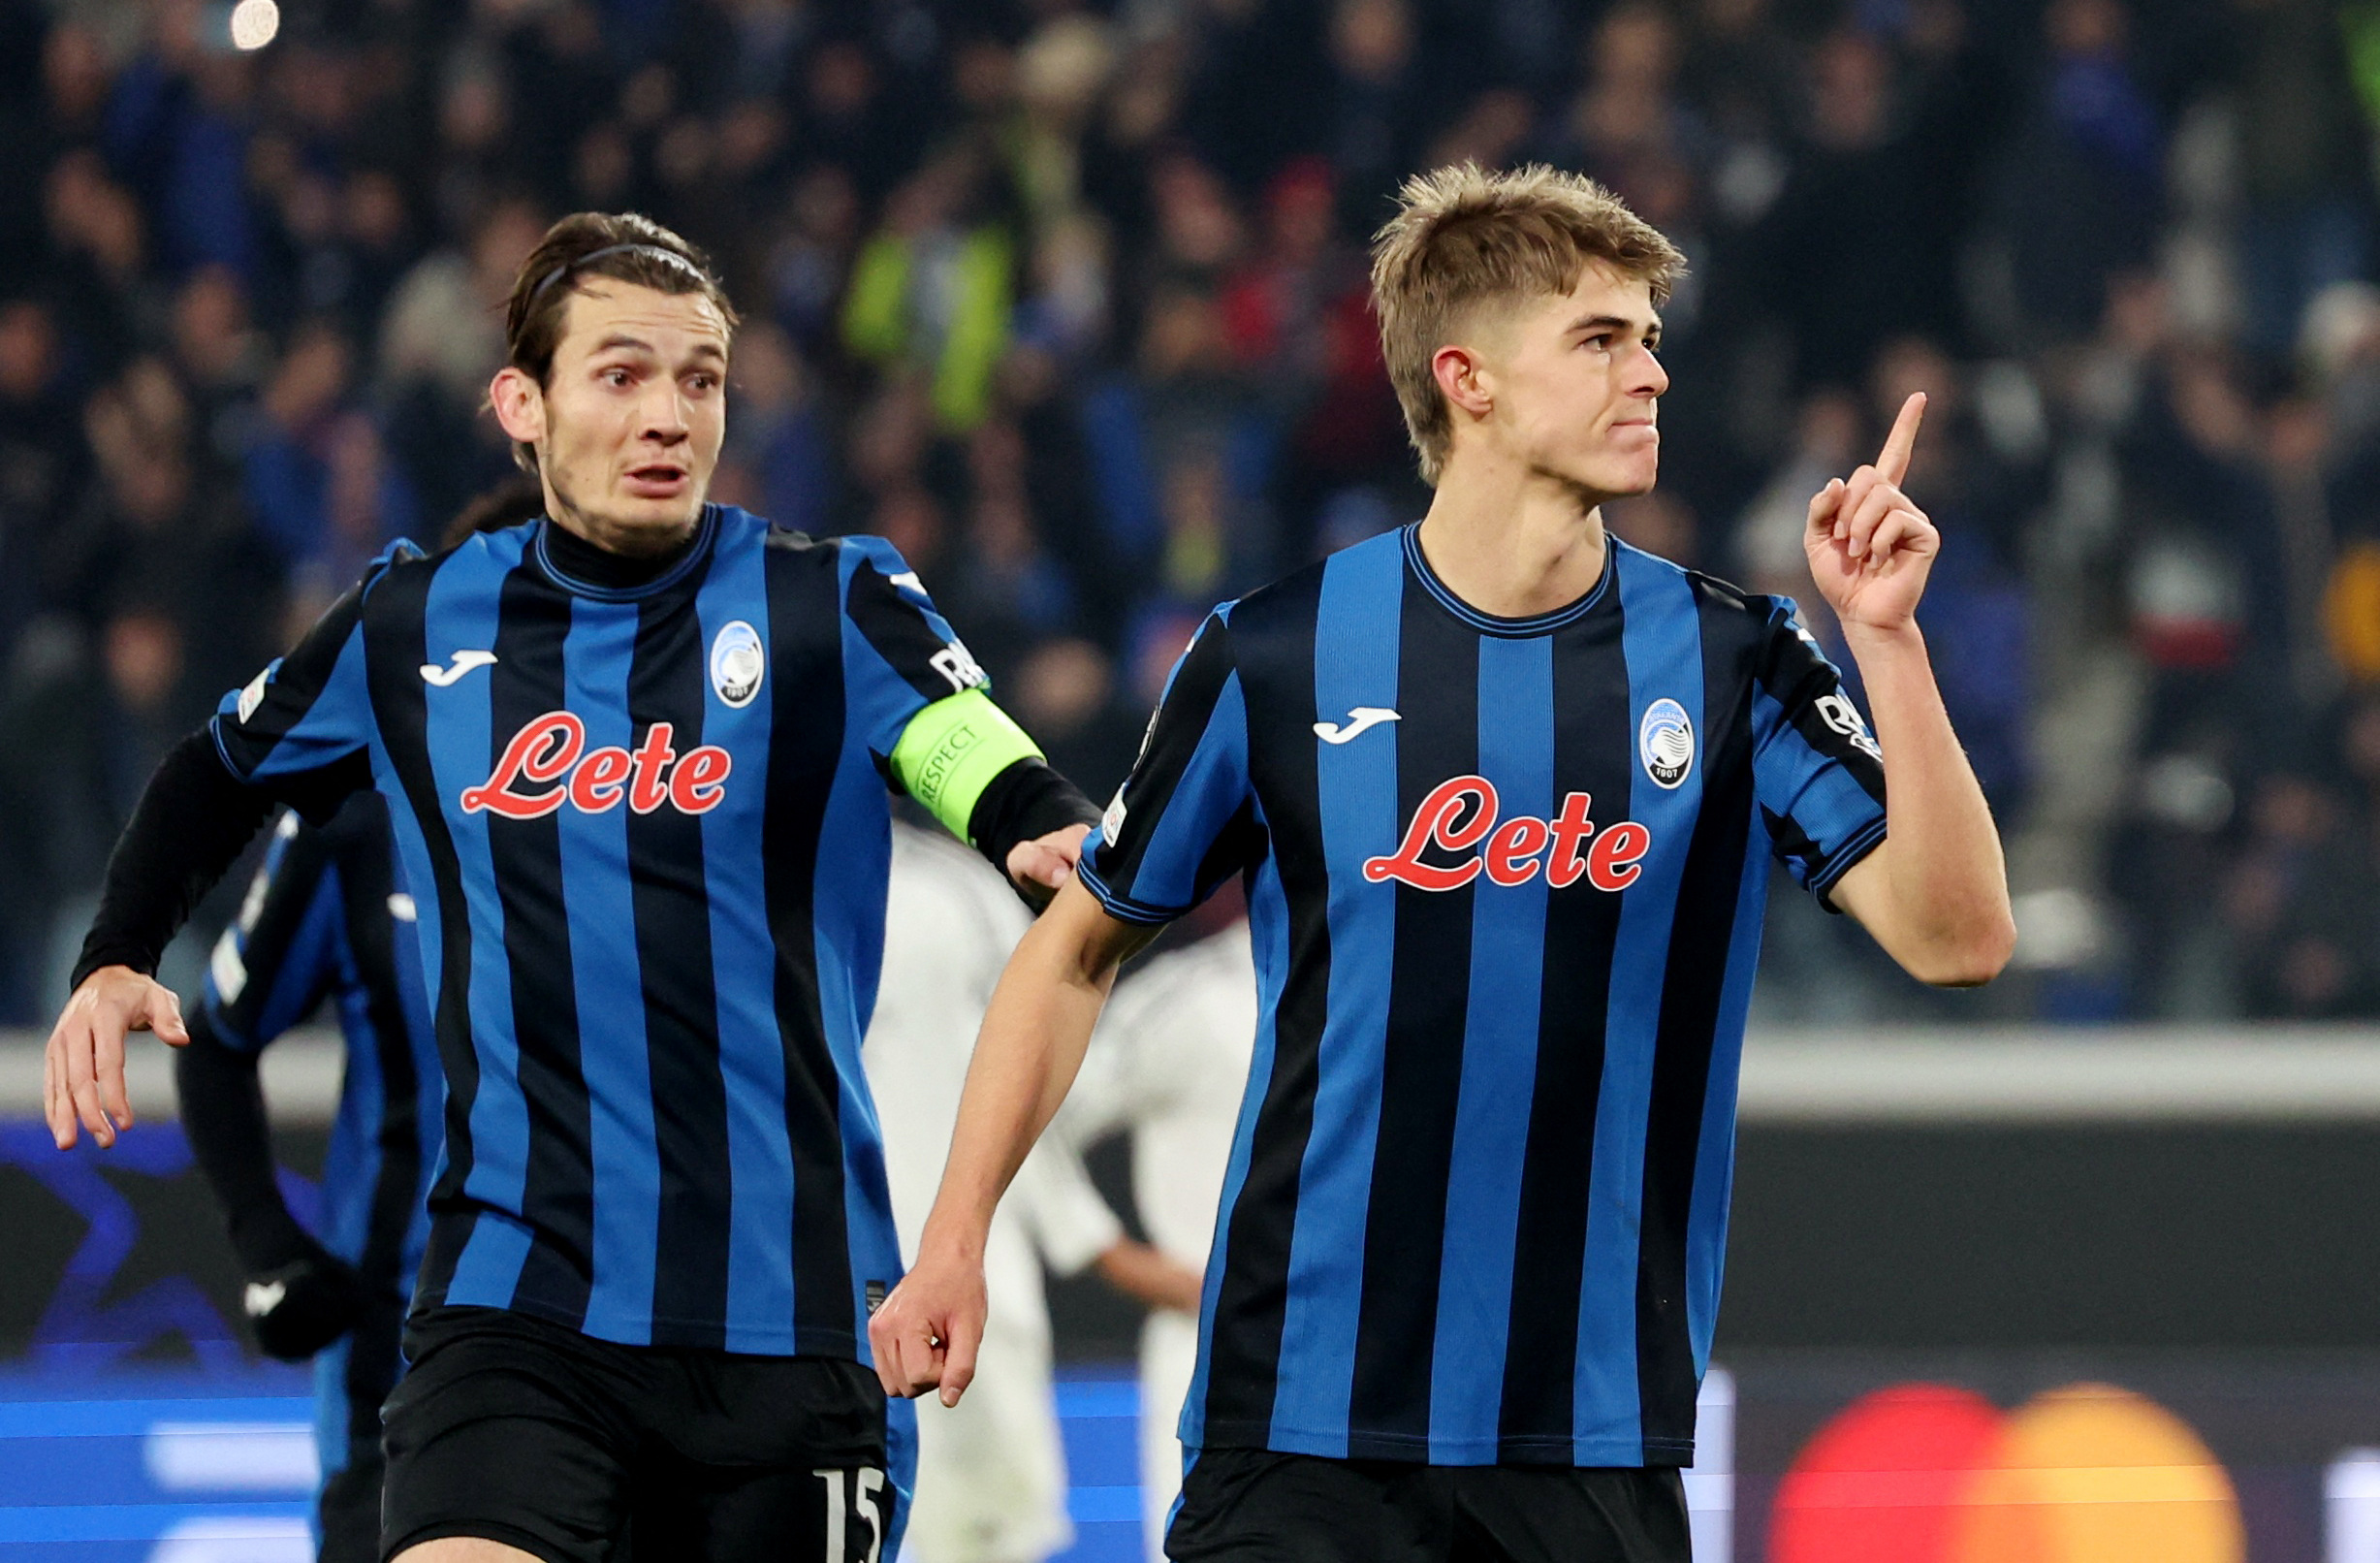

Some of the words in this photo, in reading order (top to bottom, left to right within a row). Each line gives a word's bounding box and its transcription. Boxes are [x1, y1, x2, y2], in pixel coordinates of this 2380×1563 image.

[460, 711, 732, 819] Lete
[921, 724, 976, 804] RESPECT
[1656, 767, 1678, 779] 1907
[1362, 775, 1651, 893] Lete
[812, 1465, 885, 1563] 15
